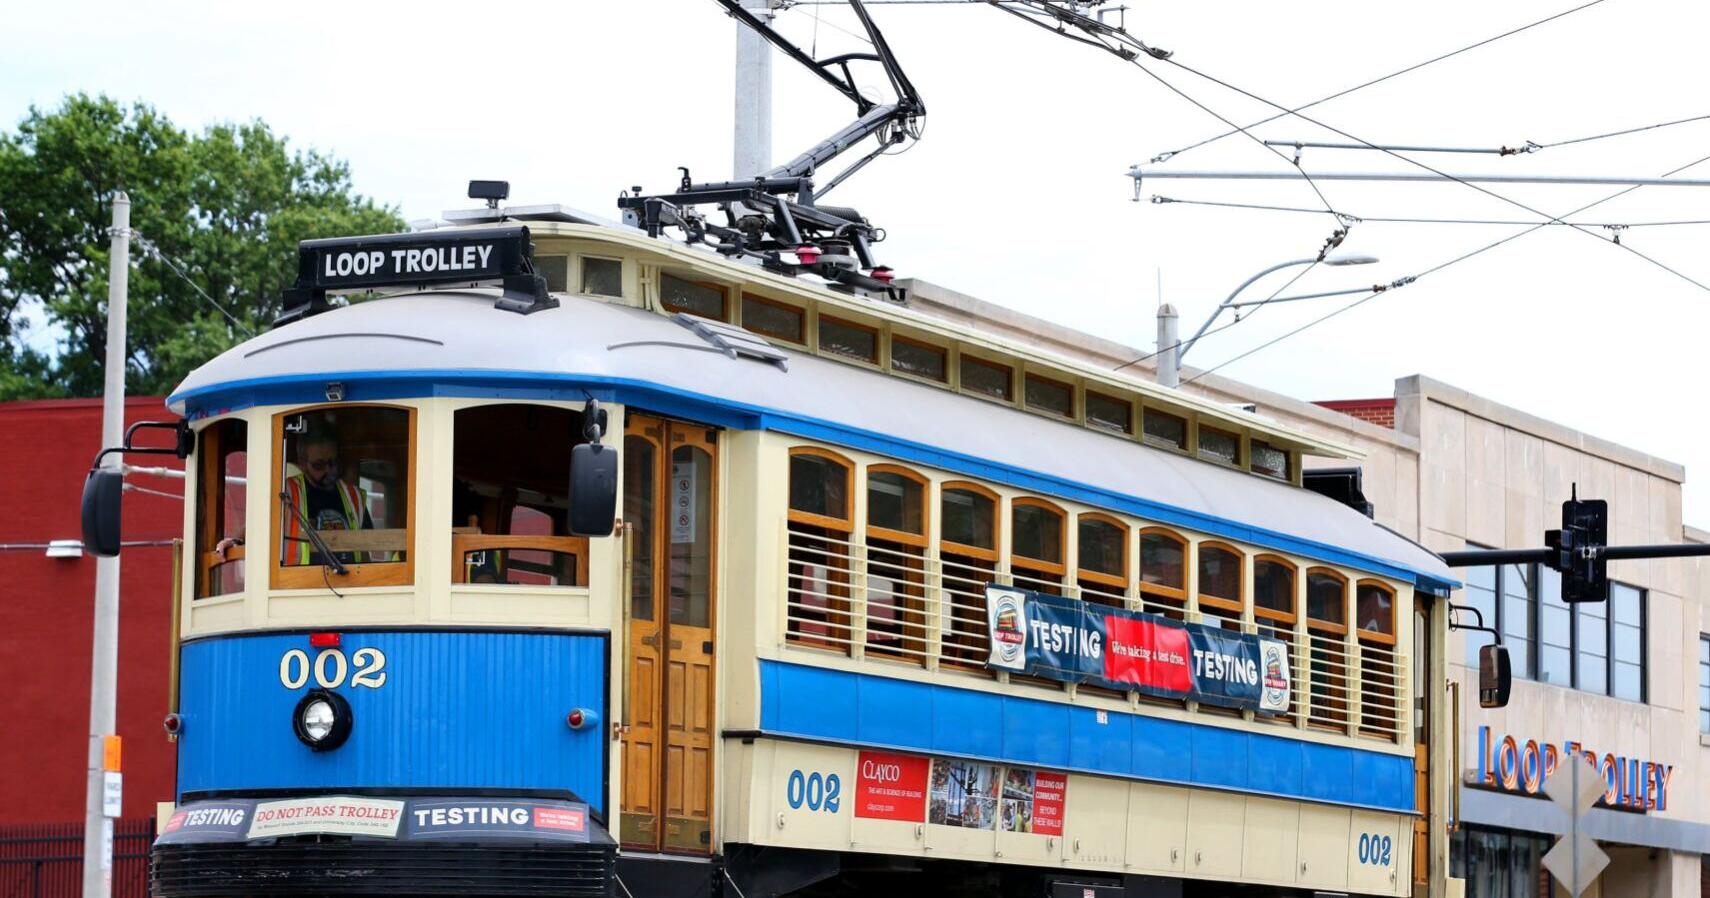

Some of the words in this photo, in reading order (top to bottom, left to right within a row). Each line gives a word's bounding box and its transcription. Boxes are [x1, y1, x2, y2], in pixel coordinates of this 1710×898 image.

[325, 251, 385, 277] LOOP
[391, 245, 493, 273] TROLLEY
[1030, 619, 1101, 659] TESTING
[1127, 645, 1150, 662] taking
[279, 647, 387, 690] 002
[1193, 649, 1258, 686] TESTING
[1478, 726, 1558, 794] LOOP
[1565, 740, 1673, 811] OLLEY
[787, 769, 840, 813] 002
[184, 808, 245, 827] TESTING
[257, 810, 275, 822] DO
[276, 807, 301, 820] NOT
[304, 805, 336, 818] PASS
[338, 805, 399, 821] TROLLEY
[414, 807, 530, 827] TESTING
[1359, 832, 1391, 866] 002
